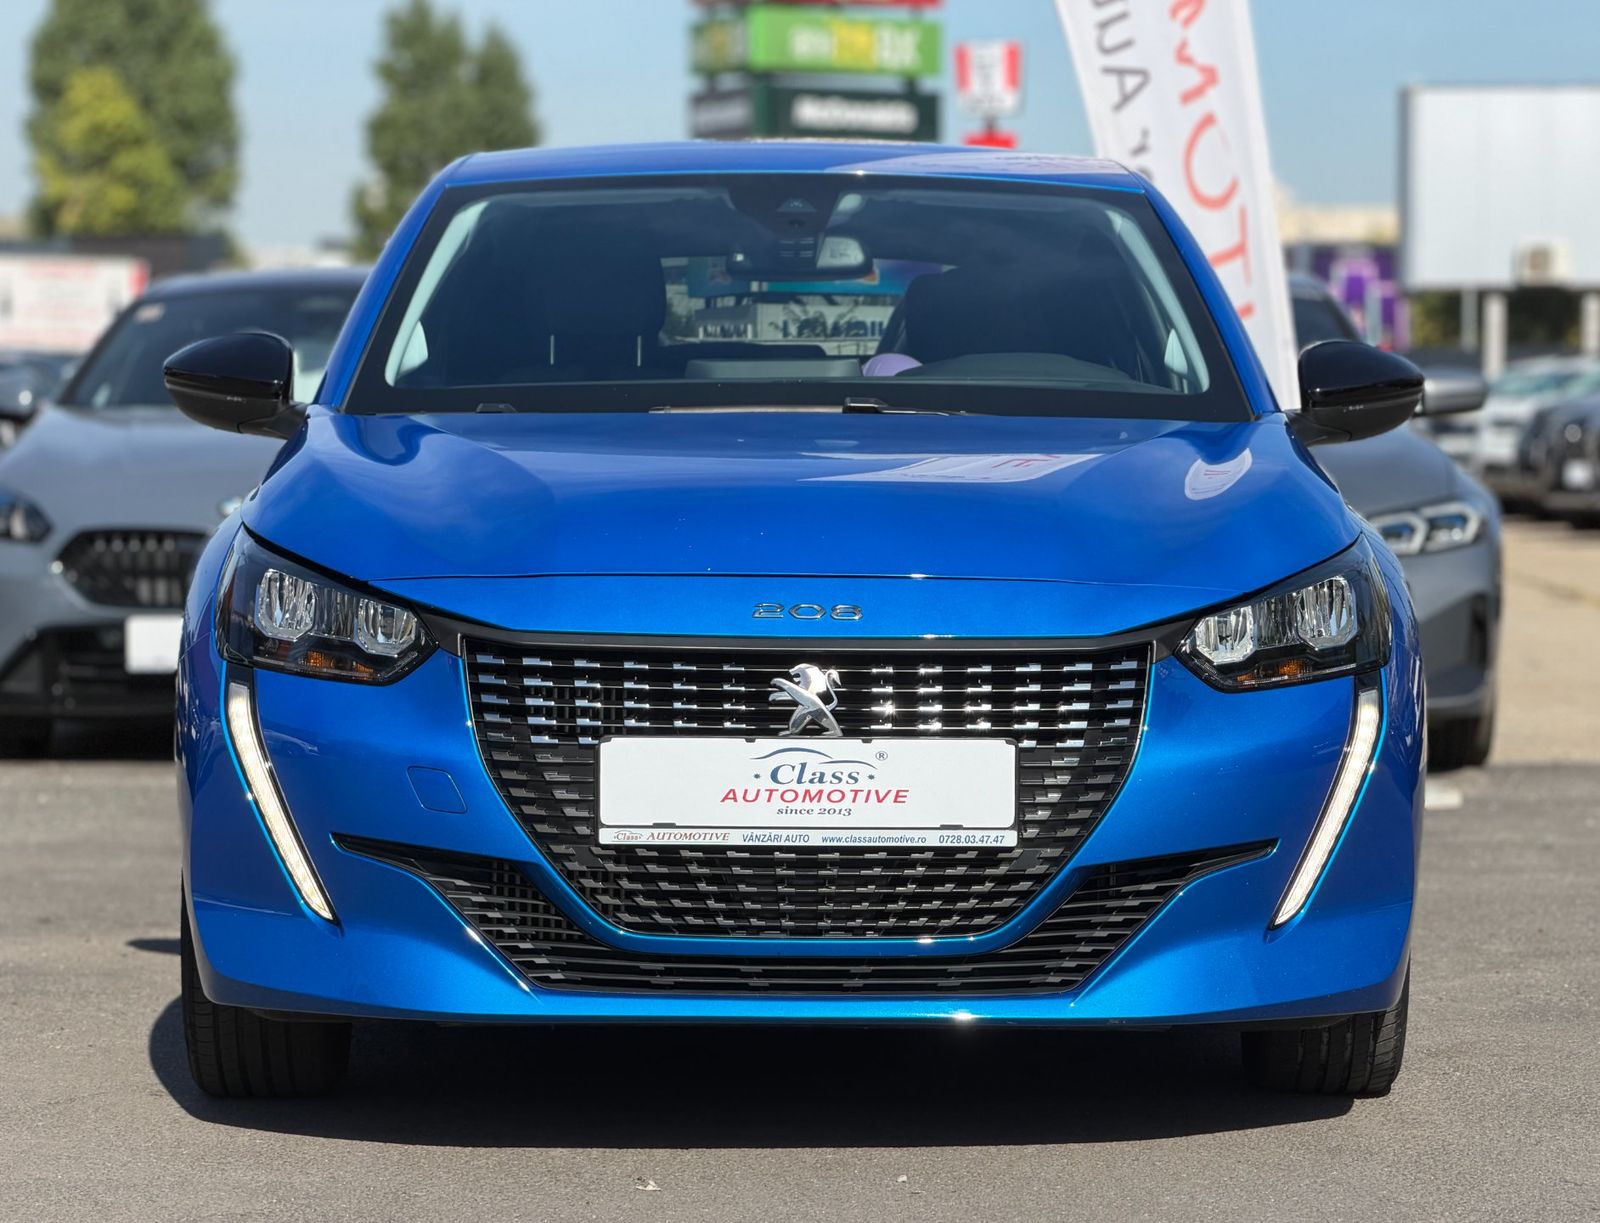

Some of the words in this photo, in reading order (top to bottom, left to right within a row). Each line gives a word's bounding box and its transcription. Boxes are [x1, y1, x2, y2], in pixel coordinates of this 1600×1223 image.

[752, 603, 863, 620] 208
[769, 761, 861, 785] Class
[720, 788, 910, 804] AUTOMOTIVE
[776, 805, 815, 816] since
[816, 807, 853, 817] 2013
[646, 832, 731, 841] AUTOMOTIVE
[784, 834, 811, 843] AUTO
[821, 834, 927, 844] www.classautomotive.ro
[938, 834, 1006, 844] 0728.03.47.47
